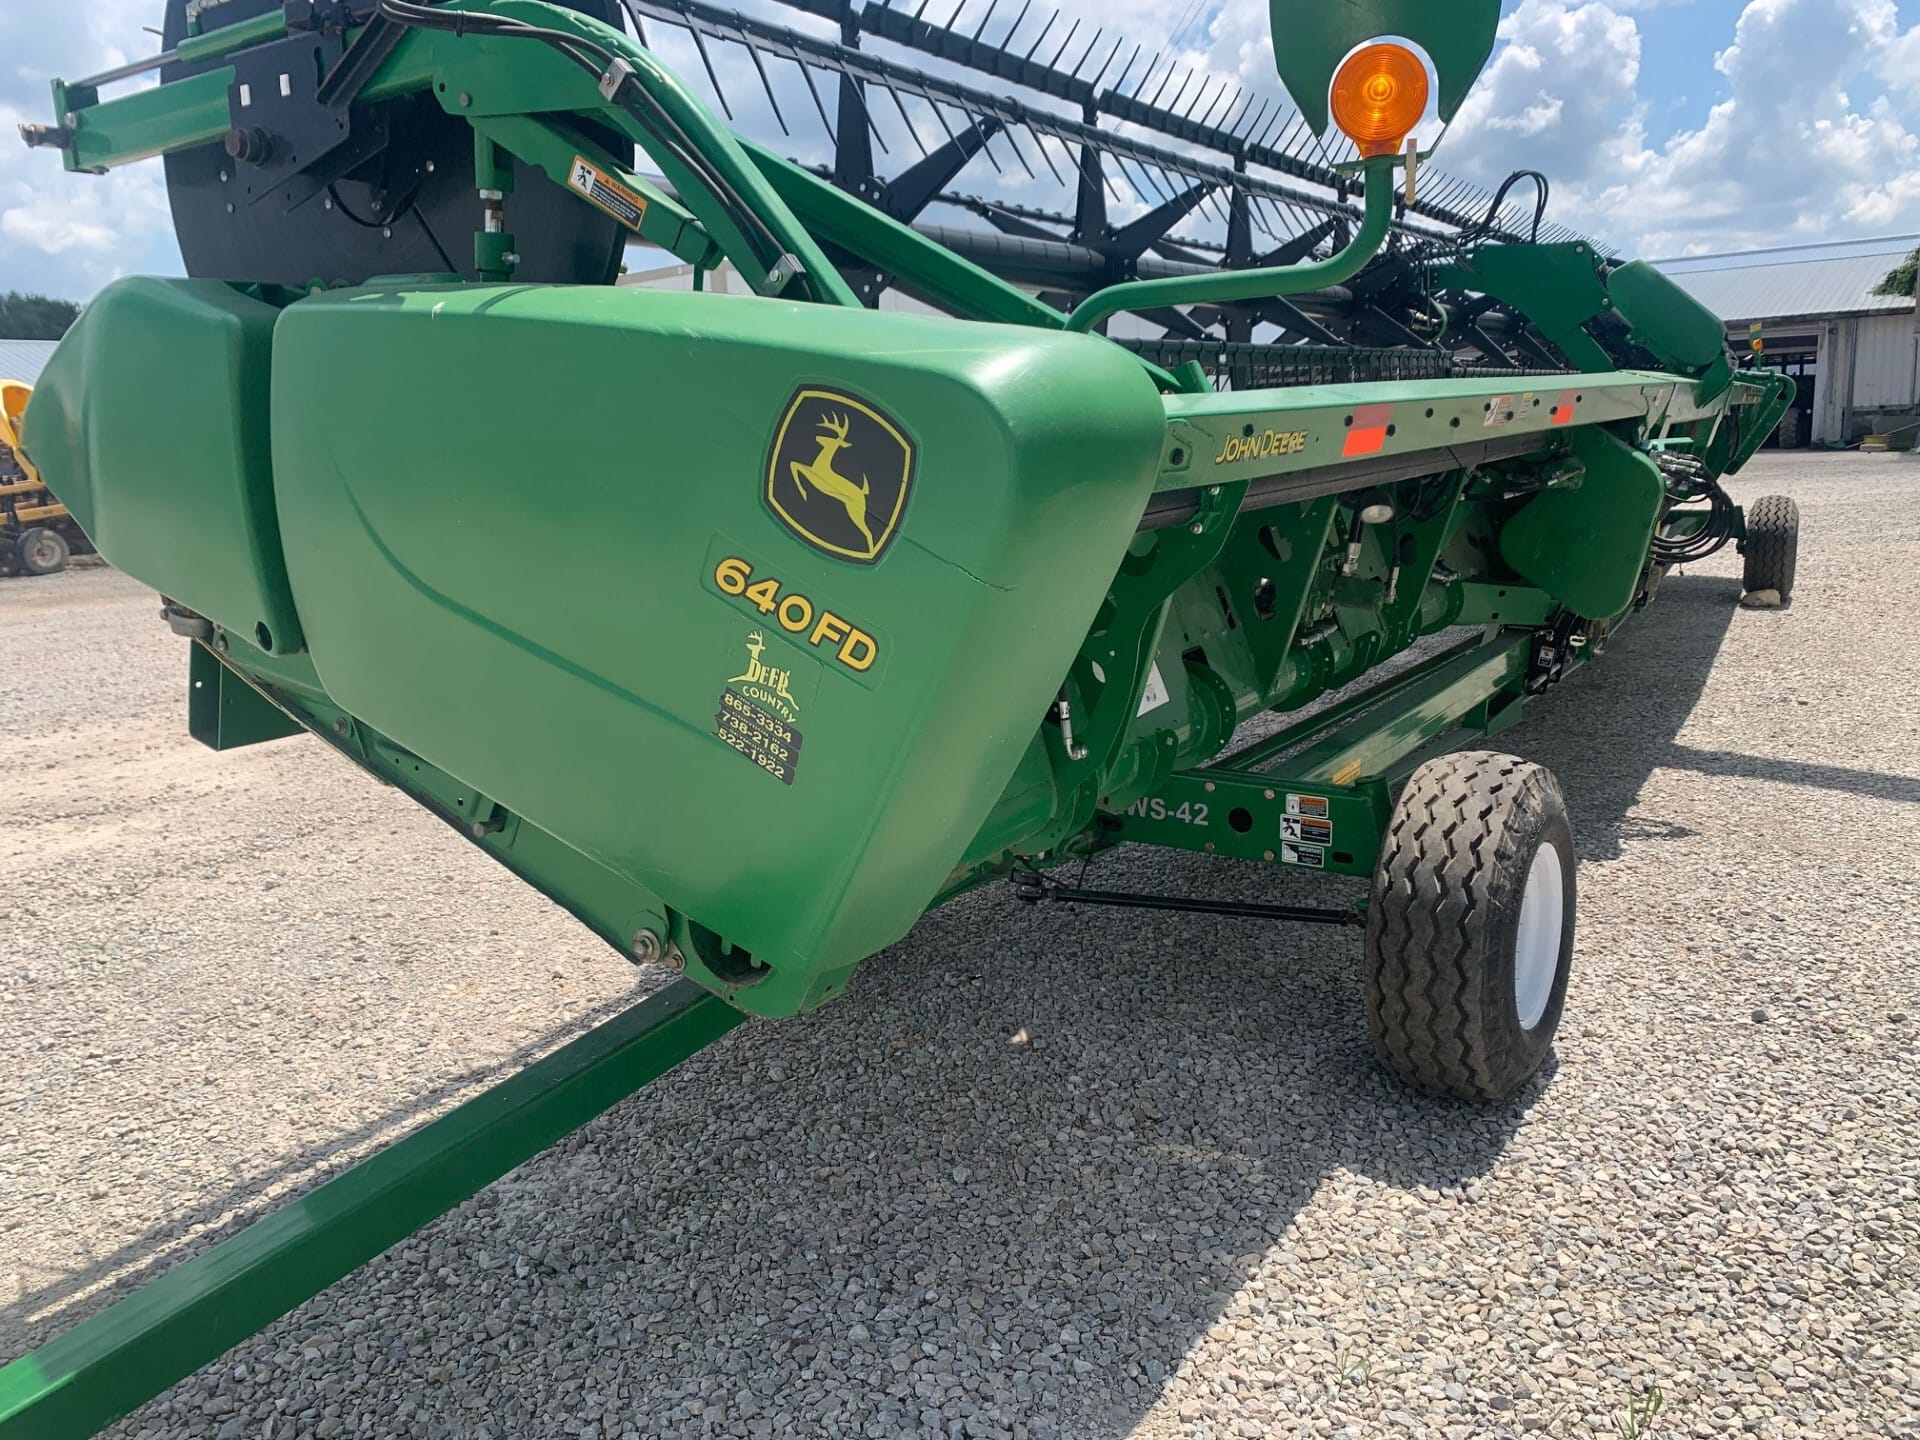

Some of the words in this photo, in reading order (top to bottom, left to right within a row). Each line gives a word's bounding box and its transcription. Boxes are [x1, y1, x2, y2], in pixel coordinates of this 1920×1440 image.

[1215, 433, 1262, 464] JOHN
[1260, 428, 1309, 457] DEERE
[714, 557, 879, 673] 640FD
[723, 692, 792, 743] 865-3334
[742, 685, 797, 723] COUNTRY
[718, 727, 785, 779] 522-1922
[721, 709, 788, 761] 738-2162
